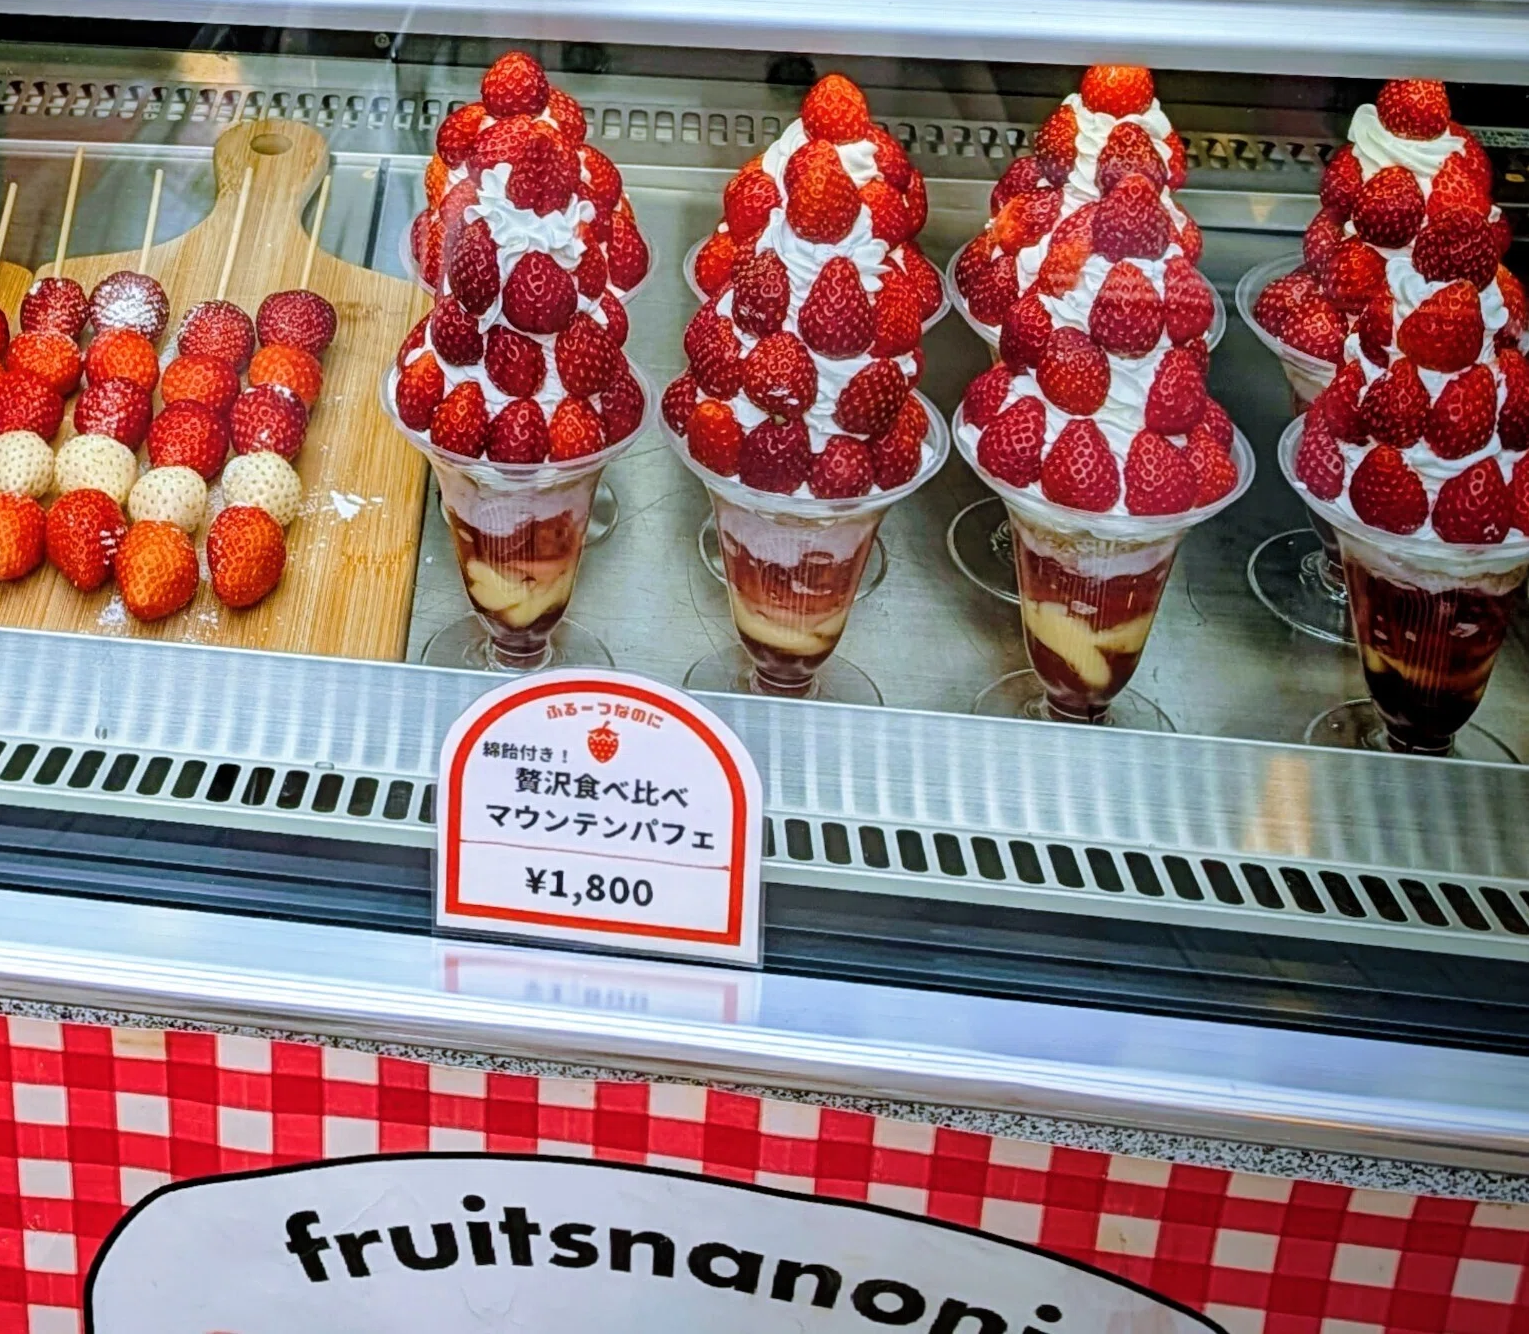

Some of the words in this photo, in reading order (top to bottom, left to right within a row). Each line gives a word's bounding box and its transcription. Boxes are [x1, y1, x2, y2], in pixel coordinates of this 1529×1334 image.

[546, 702, 665, 729] ふるーつなのに
[515, 767, 689, 808] 贅沢食べ比べ
[485, 803, 716, 851] マウンテンパフェ
[525, 867, 654, 907] ¥1,800
